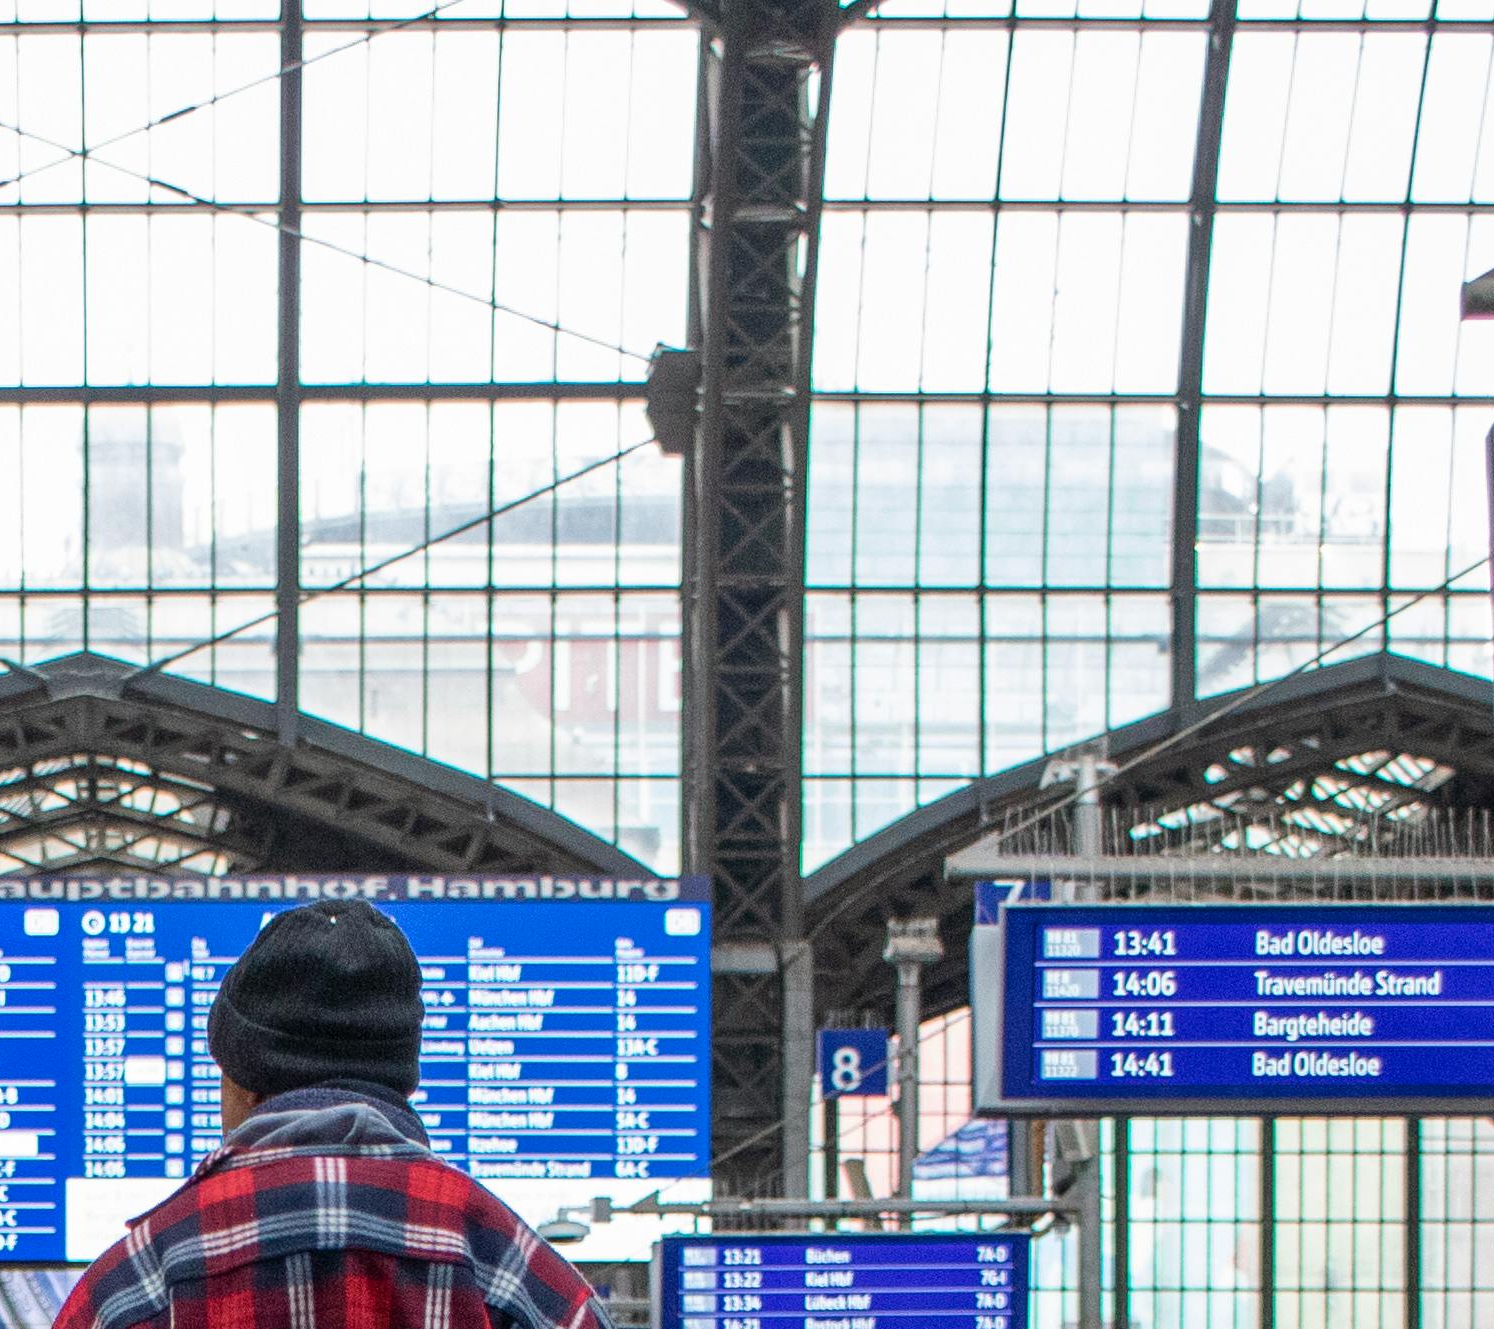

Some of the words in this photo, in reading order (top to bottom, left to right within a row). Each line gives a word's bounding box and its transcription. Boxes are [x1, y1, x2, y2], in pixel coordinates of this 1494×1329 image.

[407, 876, 681, 901] Hamburg
[1113, 930, 1178, 957] 13:41
[1254, 930, 1293, 956] Bad
[1297, 929, 1386, 956] Oldesloe
[1112, 970, 1177, 997] 14:06
[1254, 970, 1373, 997] Travemünde
[1374, 970, 1443, 996] Strand
[1111, 1011, 1176, 1037] 14:11
[1252, 1010, 1374, 1041] Bargteheide
[832, 1046, 862, 1092] 8
[1110, 1051, 1174, 1078] 14:41
[1251, 1051, 1290, 1077] Bad
[1294, 1050, 1383, 1077] Oldesloe
[723, 1248, 762, 1265] 13:21
[804, 1246, 851, 1264] Büchen
[976, 1245, 1009, 1263] 7A-D
[723, 1272, 762, 1288] 13:22
[805, 1271, 830, 1288] Kiel
[830, 1271, 854, 1287] Hbf
[723, 1295, 762, 1312] 13:34
[804, 1294, 846, 1311] Lübeck
[846, 1293, 872, 1310] Hbf
[975, 1292, 1008, 1309] 7A-D
